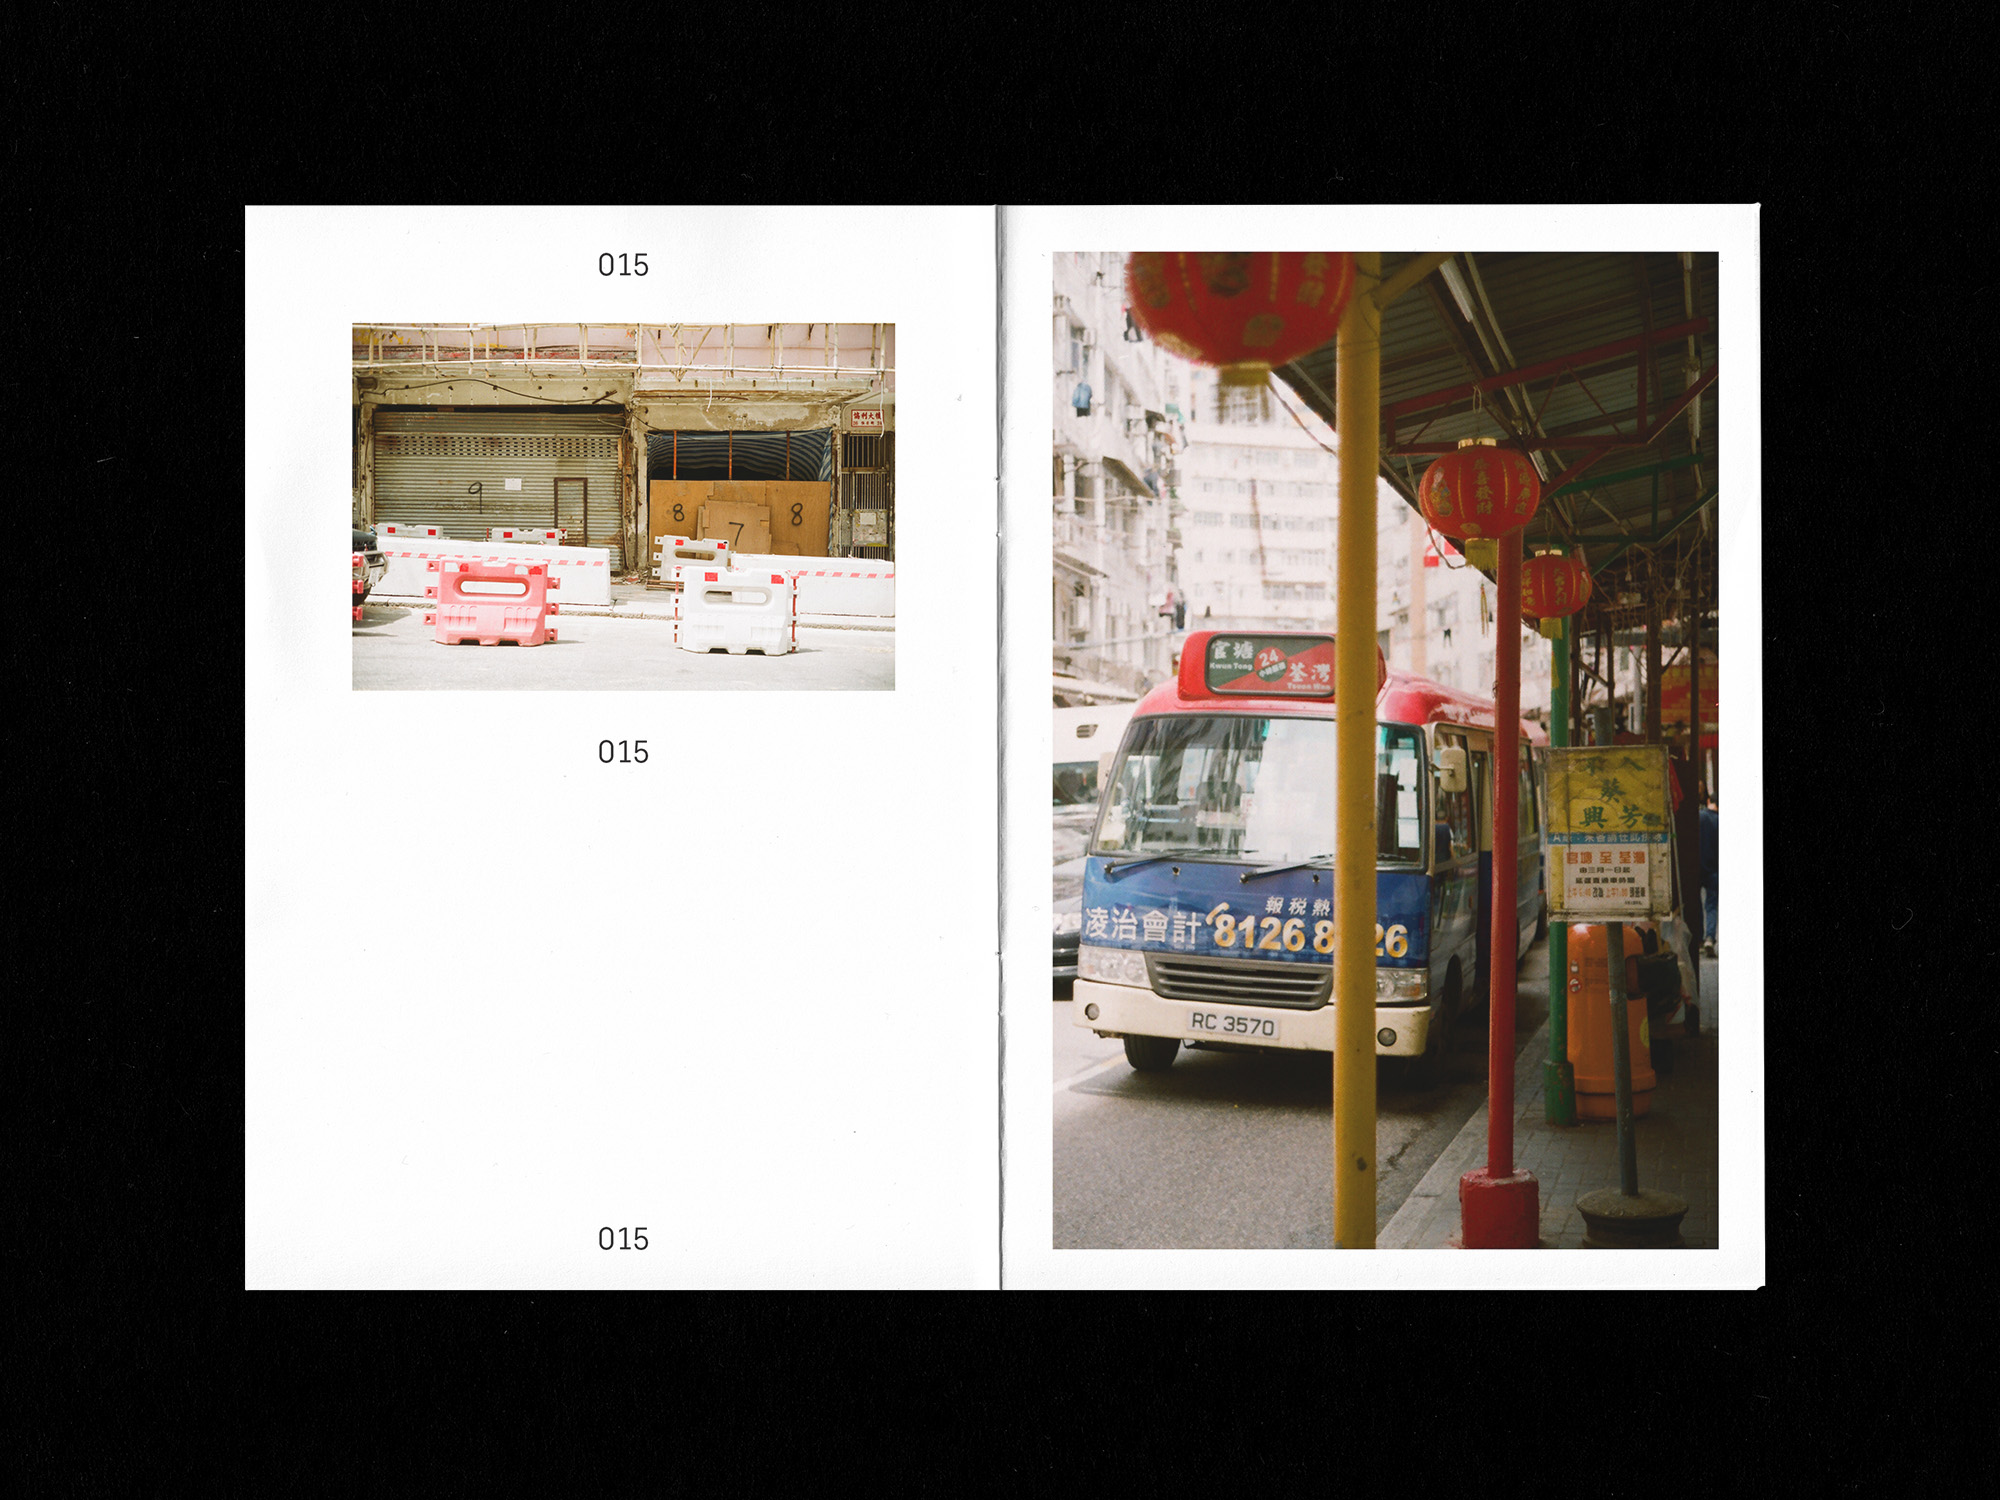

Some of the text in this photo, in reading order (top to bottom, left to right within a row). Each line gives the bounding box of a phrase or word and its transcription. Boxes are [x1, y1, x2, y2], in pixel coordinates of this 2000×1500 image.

[598, 252, 648, 276] 015
[468, 481, 483, 515] 9
[673, 503, 685, 522] 8
[791, 502, 804, 526] 8
[728, 521, 745, 546] 7
[1209, 662, 1254, 671] Kwun Tong
[1259, 649, 1279, 668] 24
[1289, 661, 1332, 683] 荃灣
[598, 739, 648, 763] 015
[1084, 905, 1203, 945] 凌治會計
[1213, 912, 1306, 952] 8126
[1192, 1012, 1275, 1036] RC 3570
[598, 1226, 648, 1250] 015
